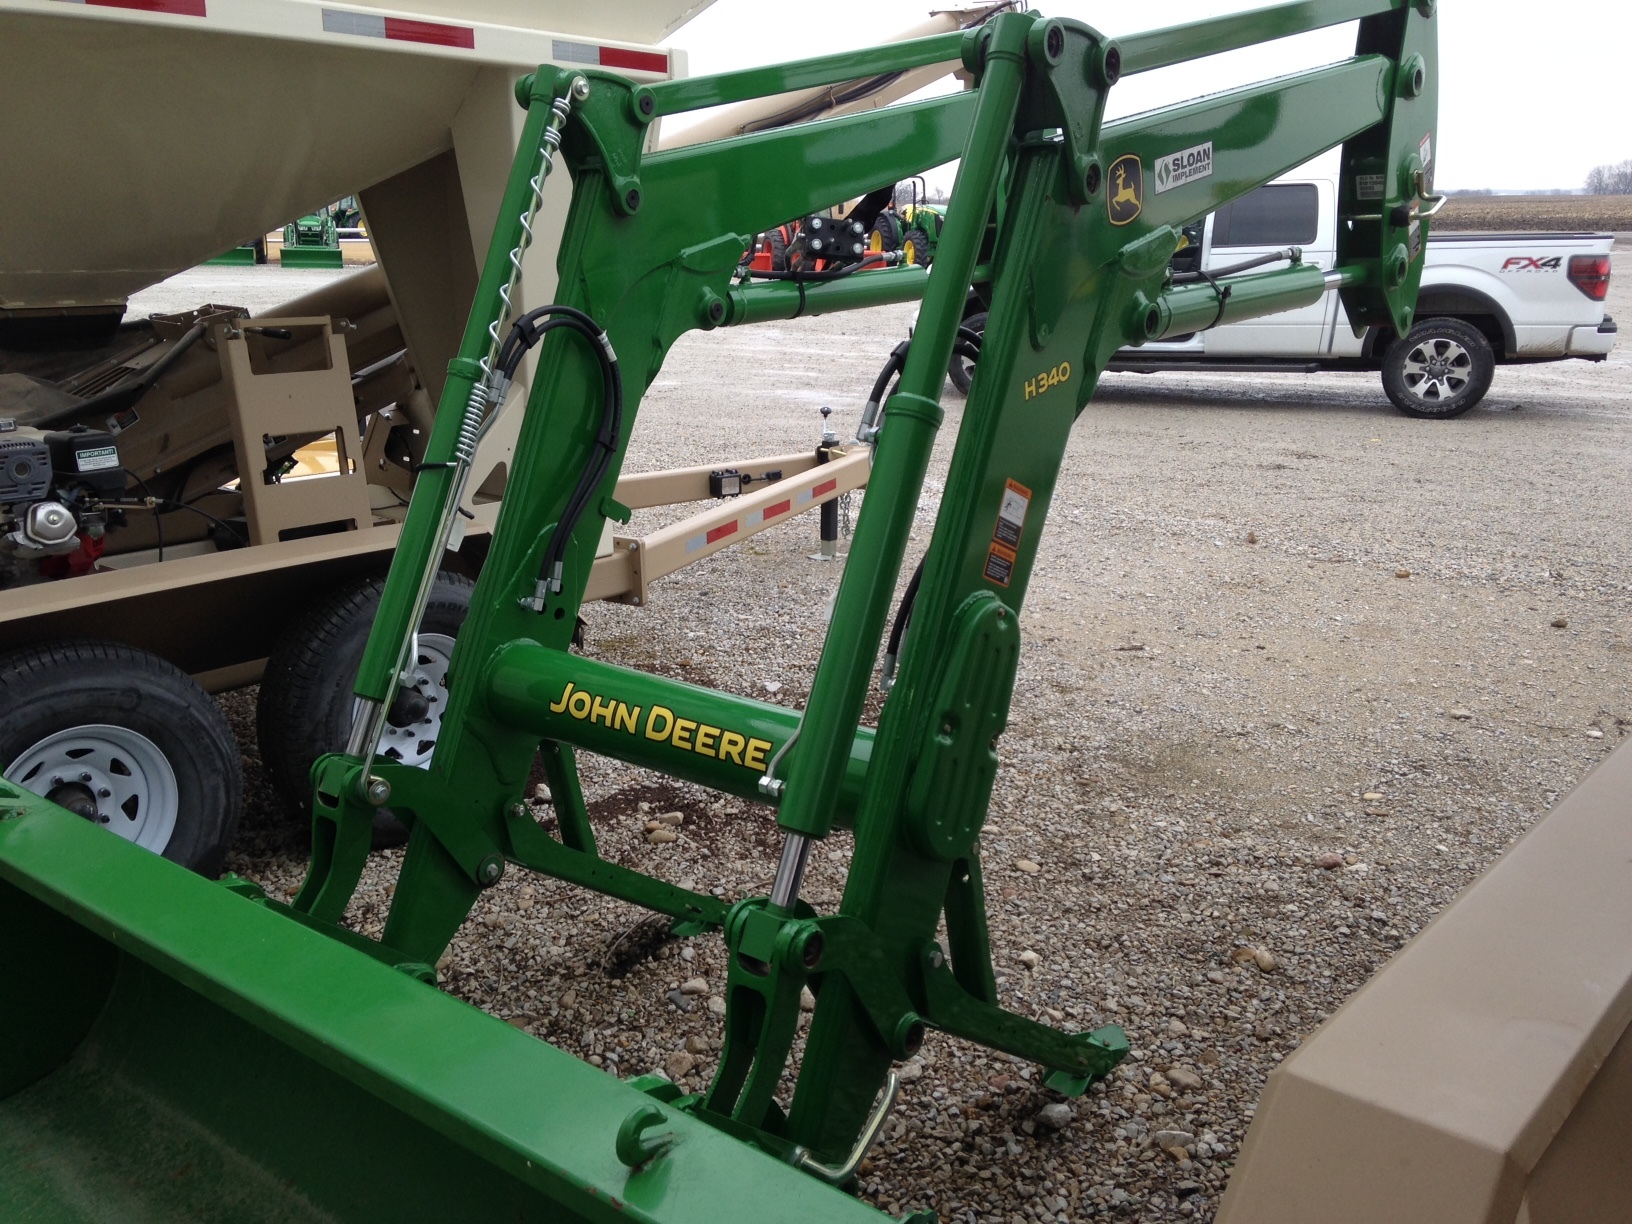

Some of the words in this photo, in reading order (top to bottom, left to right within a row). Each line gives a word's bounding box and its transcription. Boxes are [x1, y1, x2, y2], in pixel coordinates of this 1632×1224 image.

[1172, 147, 1211, 172] SLOAN
[1172, 162, 1211, 183] IMPLEMENT
[1501, 256, 1563, 270] FX4
[549, 681, 642, 735] JOHN
[644, 704, 773, 772] DEERE
